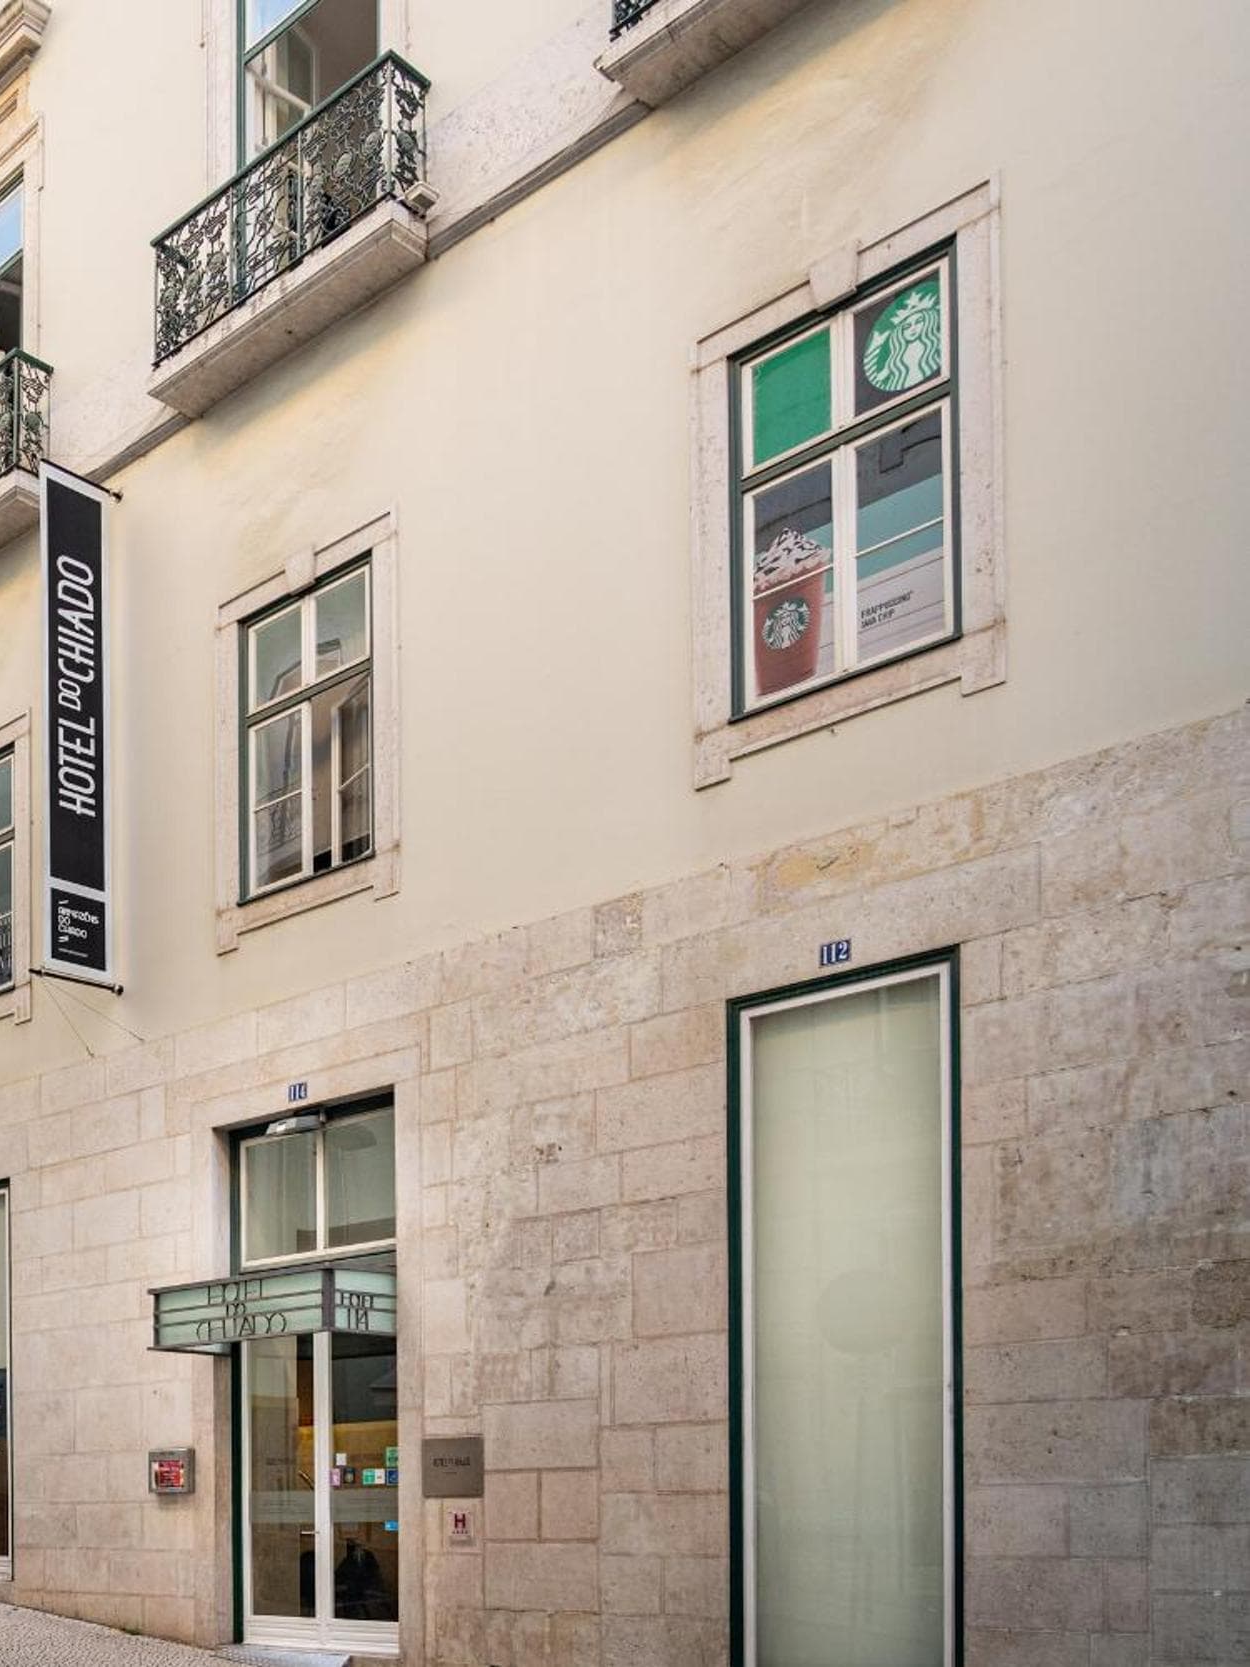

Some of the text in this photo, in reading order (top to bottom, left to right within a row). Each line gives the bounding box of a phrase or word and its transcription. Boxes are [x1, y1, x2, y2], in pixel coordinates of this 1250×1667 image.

[56, 554, 96, 818] HOTEL DO CHIADO
[822, 941, 848, 965] 112
[454, 1513, 467, 1529] H
